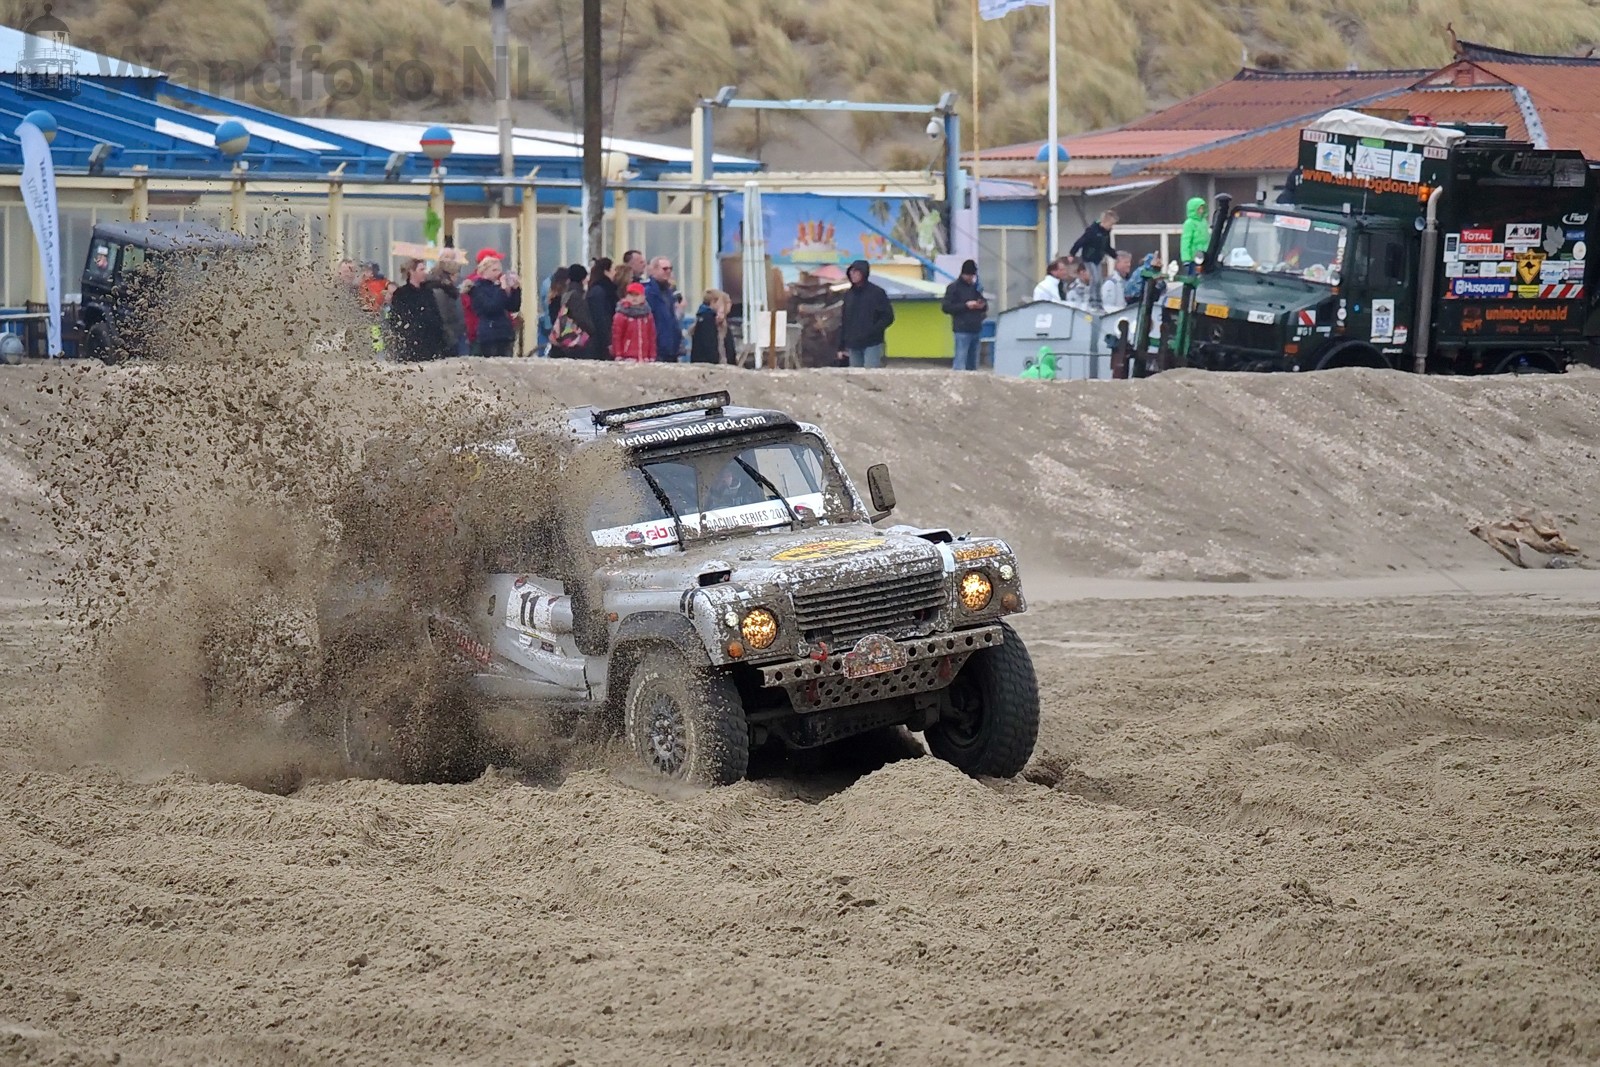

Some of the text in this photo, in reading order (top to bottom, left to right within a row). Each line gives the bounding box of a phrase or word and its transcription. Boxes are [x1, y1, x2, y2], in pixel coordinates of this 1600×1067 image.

[1303, 168, 1428, 196] www.unimogdonal
[1464, 282, 1505, 294] Husqvarna
[1485, 305, 1569, 324] unimogdonald
[740, 510, 769, 525] SERIES
